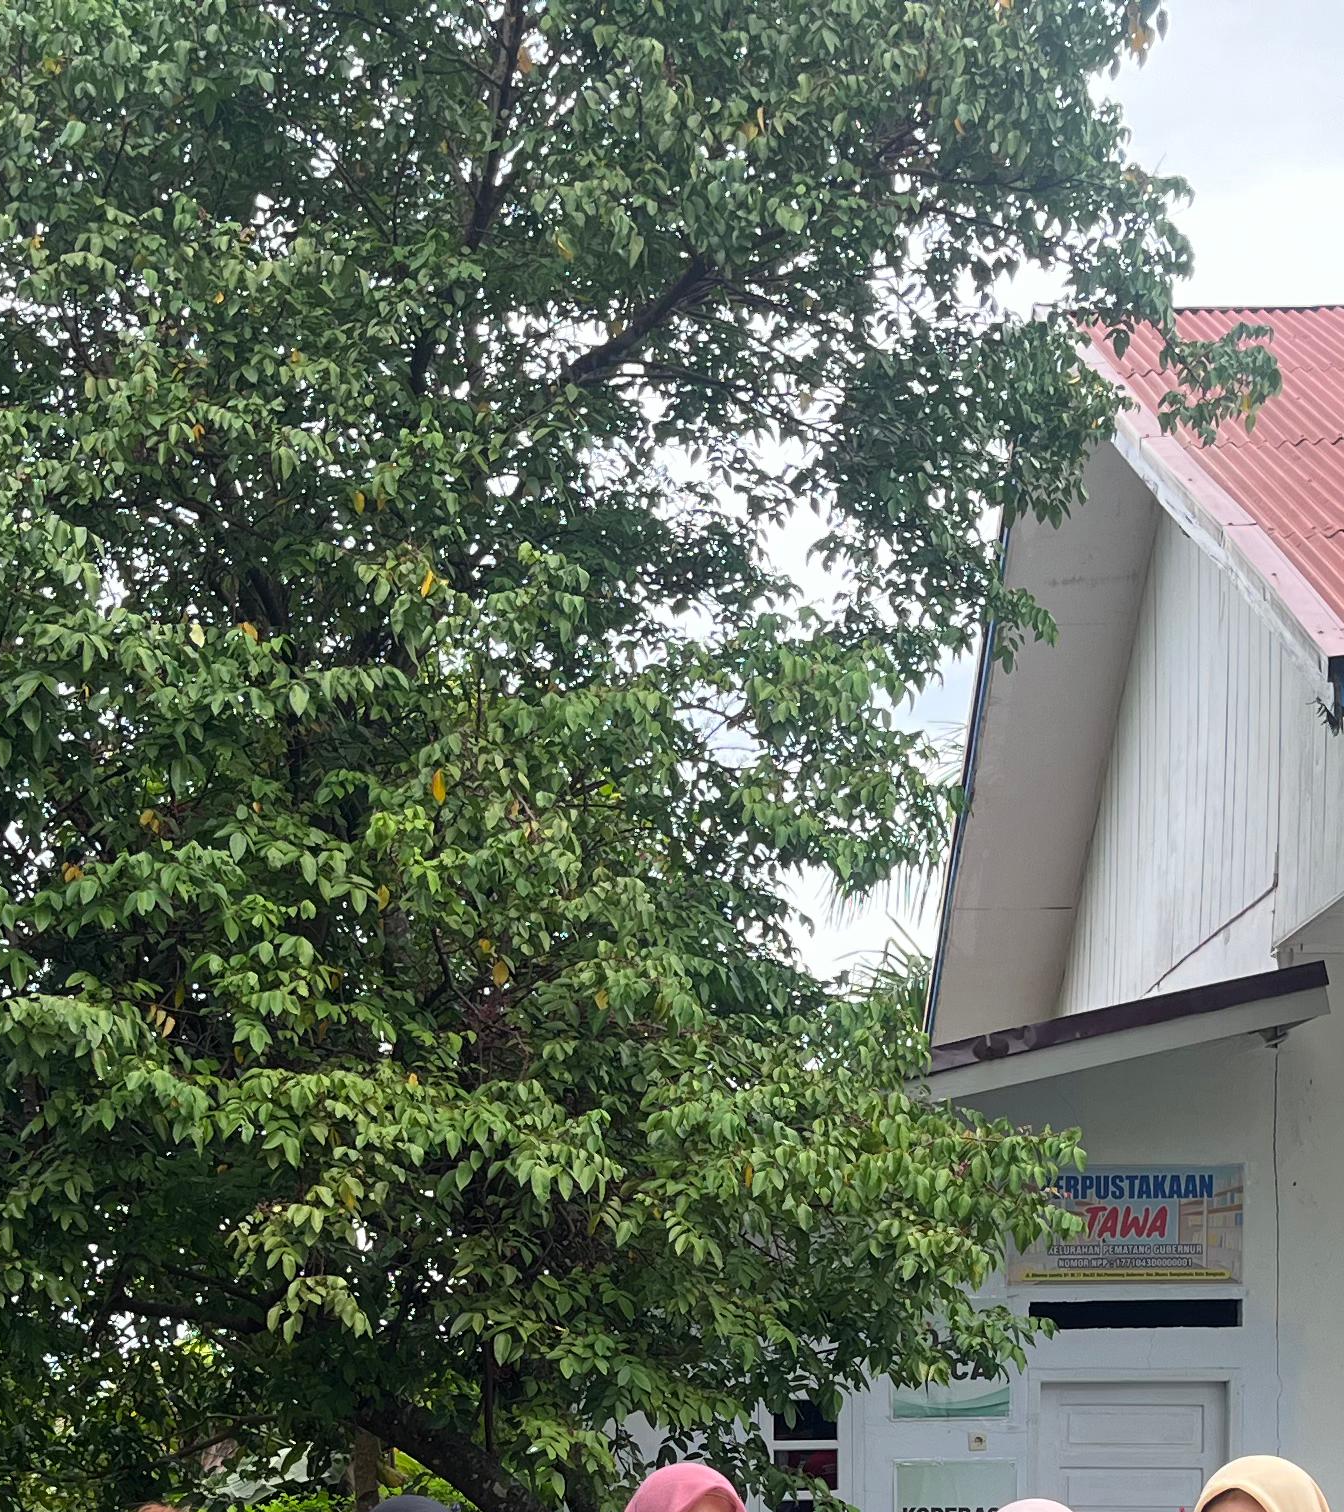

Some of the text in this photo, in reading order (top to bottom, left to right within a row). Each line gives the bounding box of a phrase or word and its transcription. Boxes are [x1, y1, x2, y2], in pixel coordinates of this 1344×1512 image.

[1046, 1174, 1214, 1200] ERPUSTAKAAN
[1084, 1205, 1168, 1239] TAWA
[1103, 1244, 1152, 1255] PEMATANG
[1153, 1243, 1203, 1255] GUBERNUR
[1058, 1258, 1089, 1268] NOMOR
